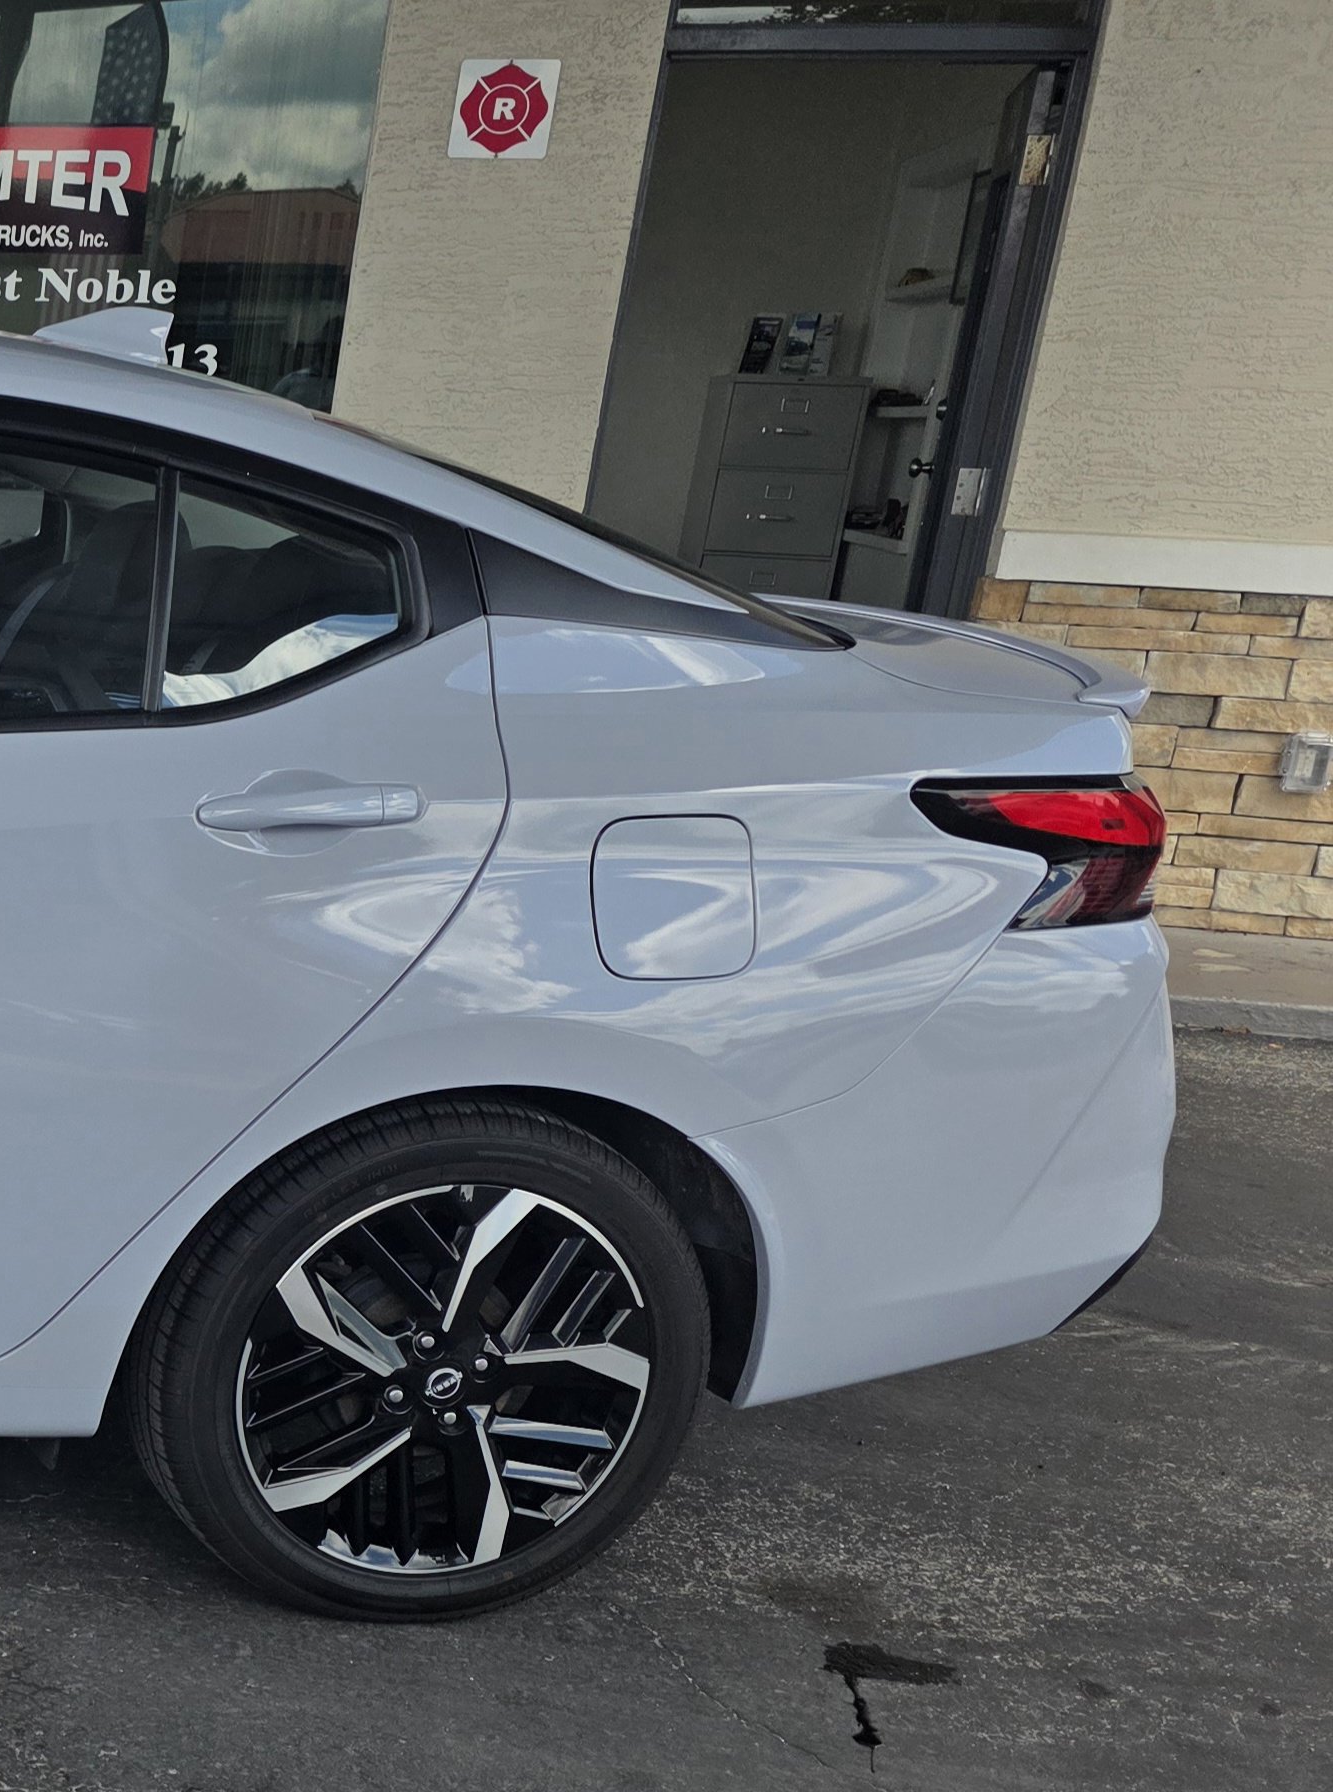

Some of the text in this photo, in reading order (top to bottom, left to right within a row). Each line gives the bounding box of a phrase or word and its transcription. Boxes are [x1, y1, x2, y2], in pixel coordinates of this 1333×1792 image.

[493, 98, 516, 120] R
[79, 229, 109, 248] Inc.
[35, 267, 177, 304] Noble
